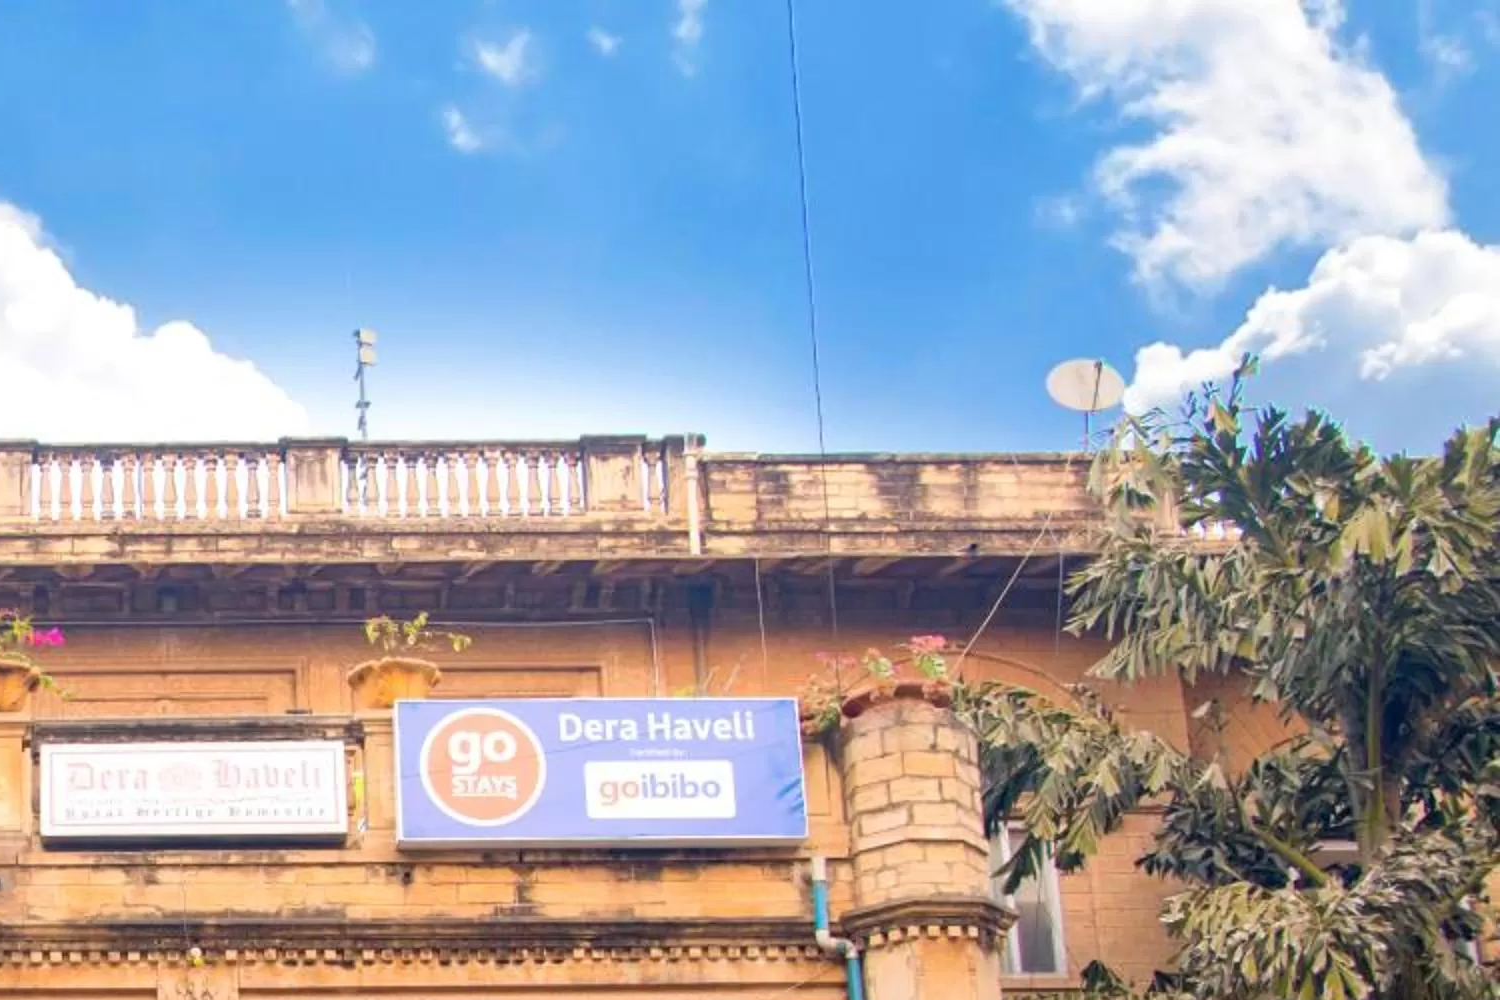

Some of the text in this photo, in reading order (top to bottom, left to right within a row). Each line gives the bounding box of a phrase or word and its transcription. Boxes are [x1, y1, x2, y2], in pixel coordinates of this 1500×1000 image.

[559, 711, 756, 742] Dera Haveli
[448, 729, 517, 776] go
[66, 758, 322, 792] Dera Haveli
[451, 775, 518, 794] STAYS
[599, 773, 721, 806] goibibo
